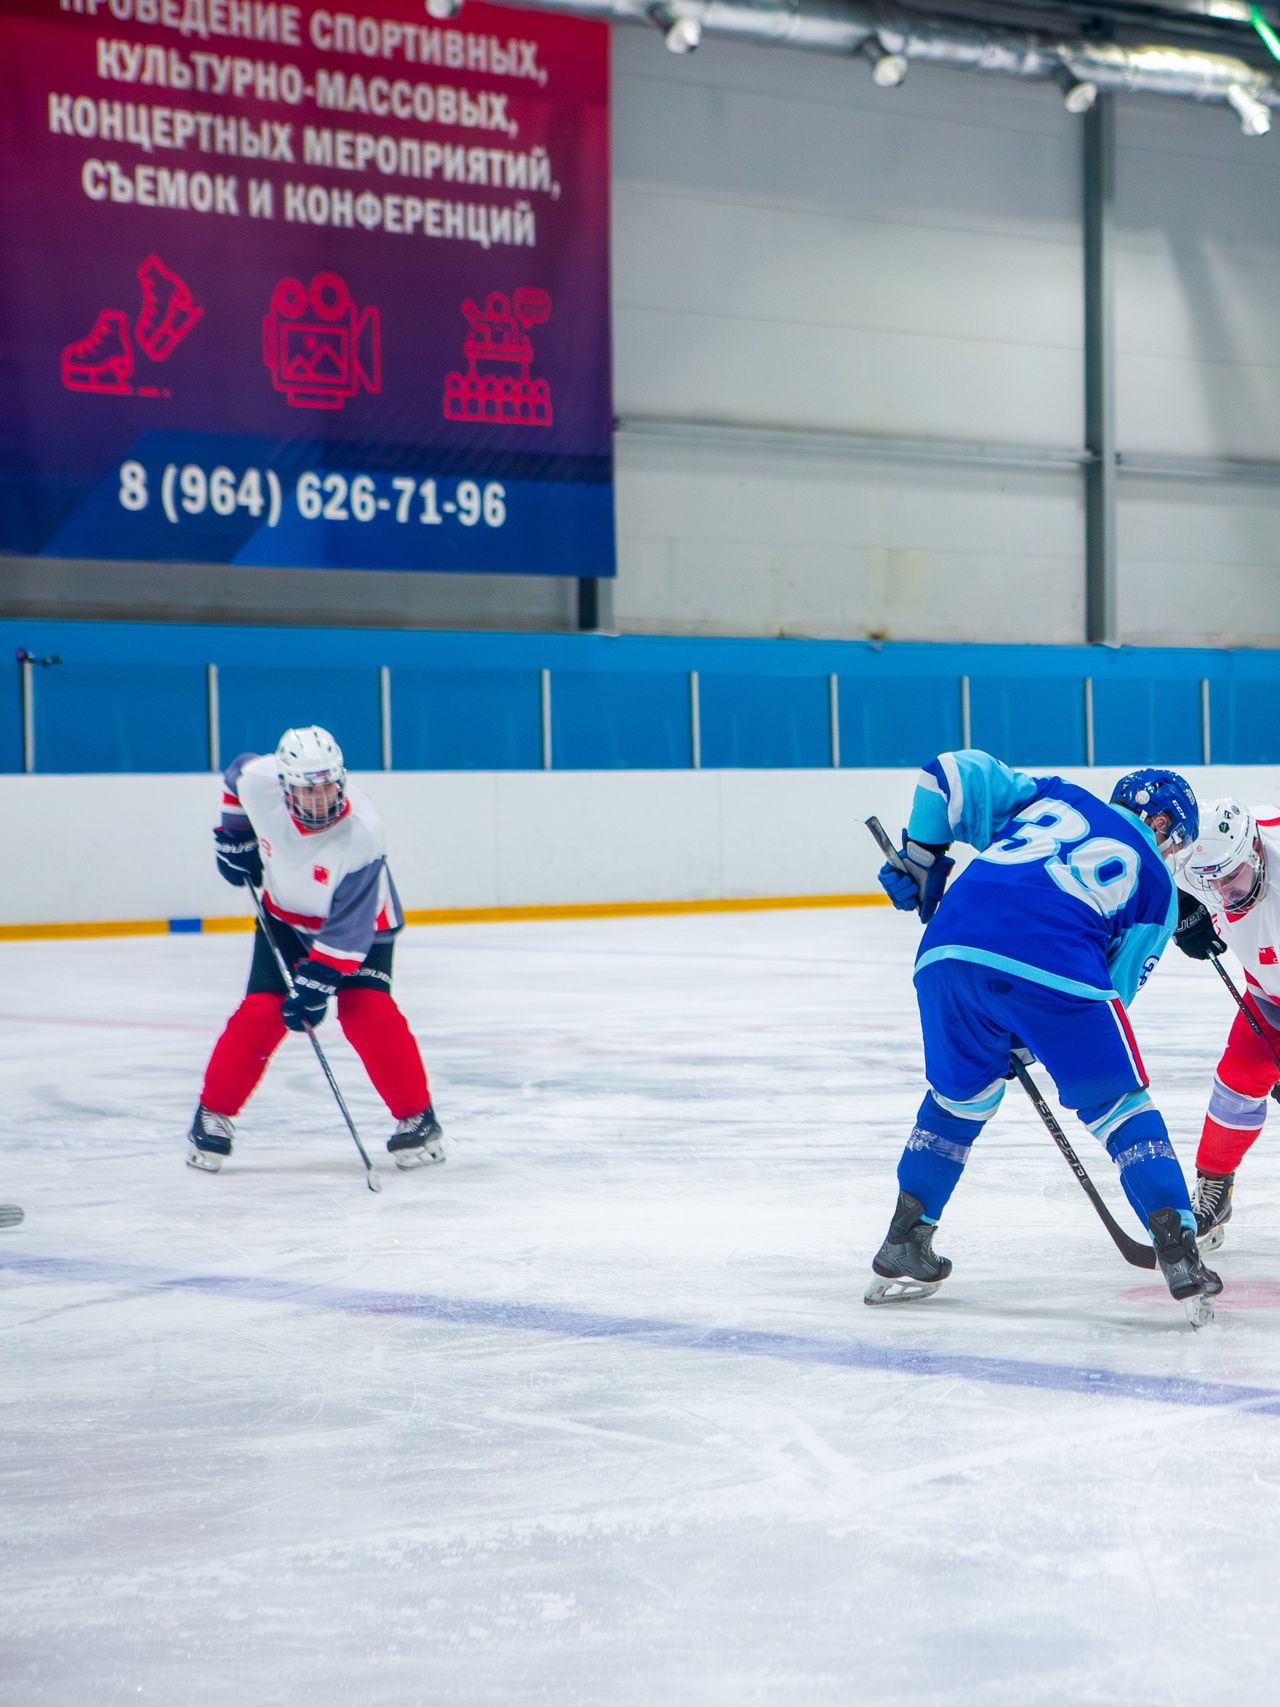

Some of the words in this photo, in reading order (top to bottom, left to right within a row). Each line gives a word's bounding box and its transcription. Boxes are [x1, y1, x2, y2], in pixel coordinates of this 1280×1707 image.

[60, 0, 301, 46] ОВЕДЕНИЕ
[310, 10, 548, 86] СПОРТИВНЫХ,
[97, 37, 518, 138] КУЛЬТУРНО-МАССОВЫХ,
[48, 92, 294, 163] КОНЦЕРТНЫХ
[303, 126, 560, 198] МЕРОПРИЯТИЙ,
[82, 159, 238, 216] СЪЕМОК
[249, 179, 273, 219] И
[284, 182, 536, 248] КОНФЕРЕНЦИЙ
[119, 460, 147, 511] 8
[162, 463, 282, 527] (964)
[297, 472, 507, 527] 626-71-96
[1172, 799, 1187, 820] CCM
[974, 797, 1141, 919] 39
